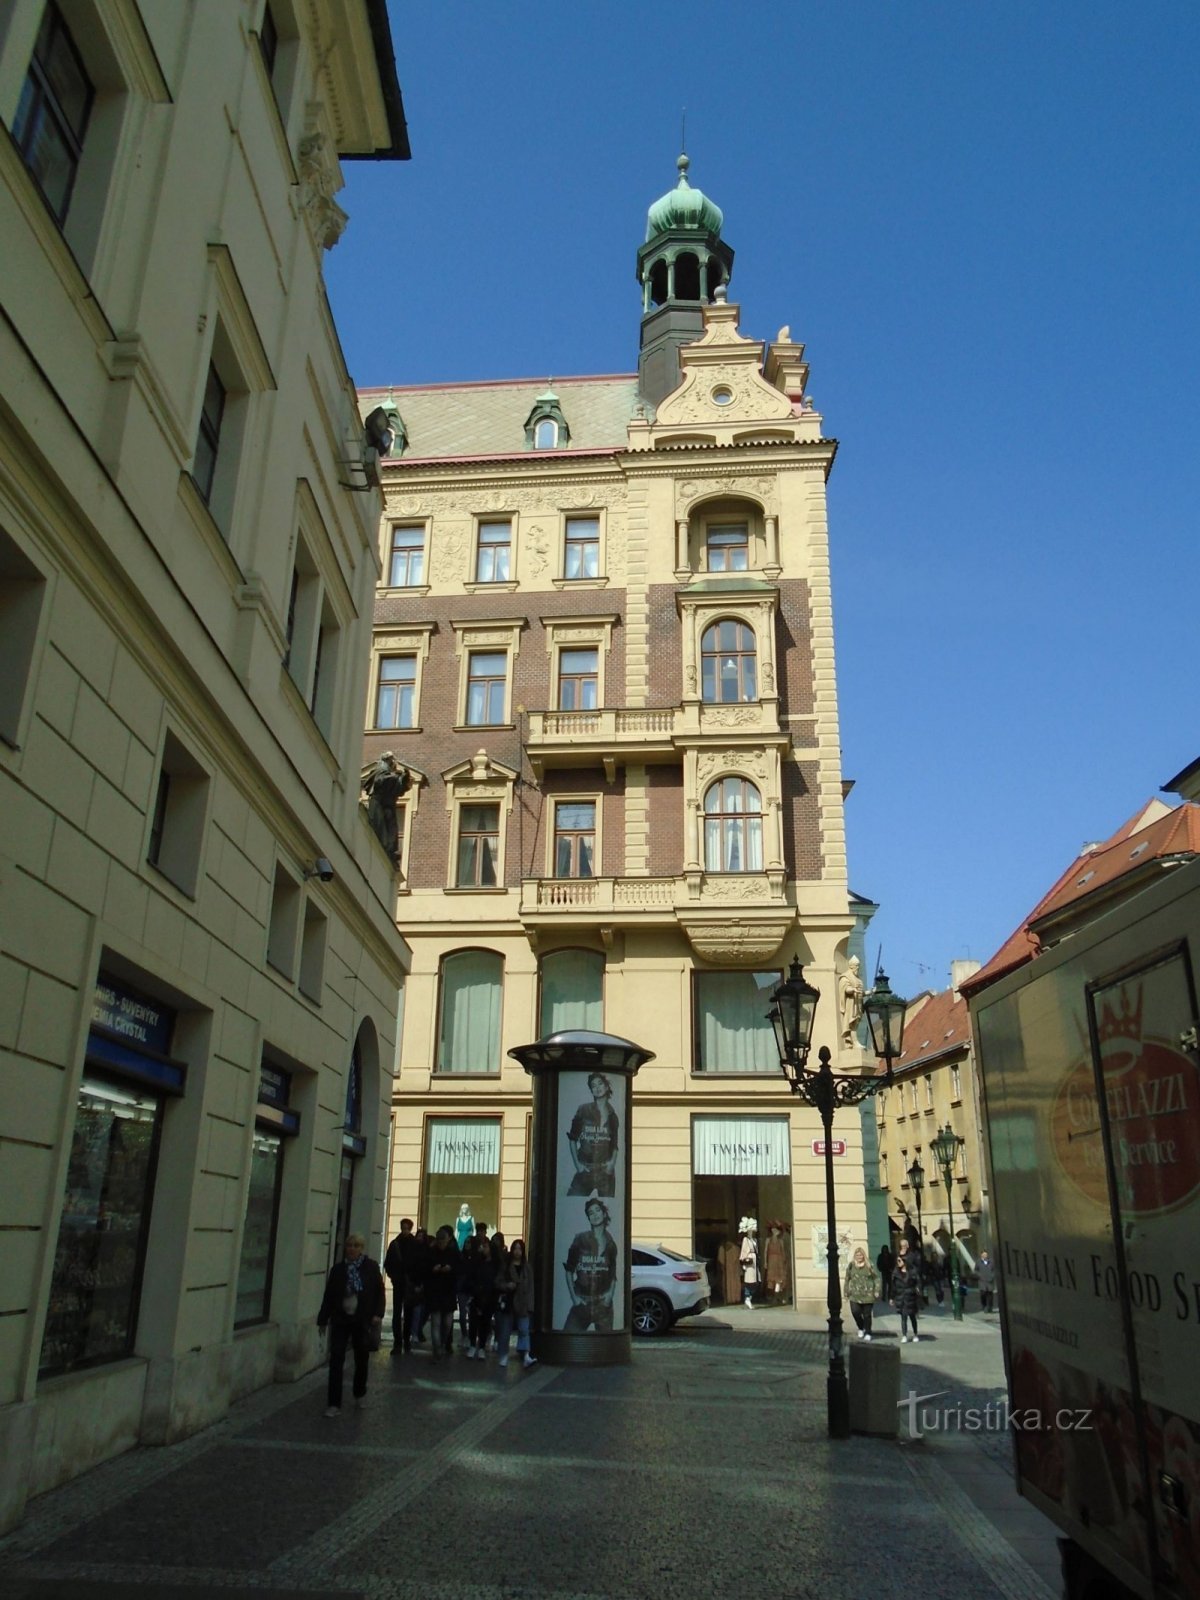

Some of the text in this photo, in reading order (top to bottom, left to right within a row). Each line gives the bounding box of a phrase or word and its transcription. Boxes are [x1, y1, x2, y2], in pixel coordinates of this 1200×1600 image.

[114, 1016, 147, 1042] CRYSTAL
[435, 1140, 496, 1154] TWINSET
[710, 1143, 772, 1155] TWINSET
[1120, 1136, 1177, 1167] Service
[1004, 1240, 1077, 1291] ITALIAN
